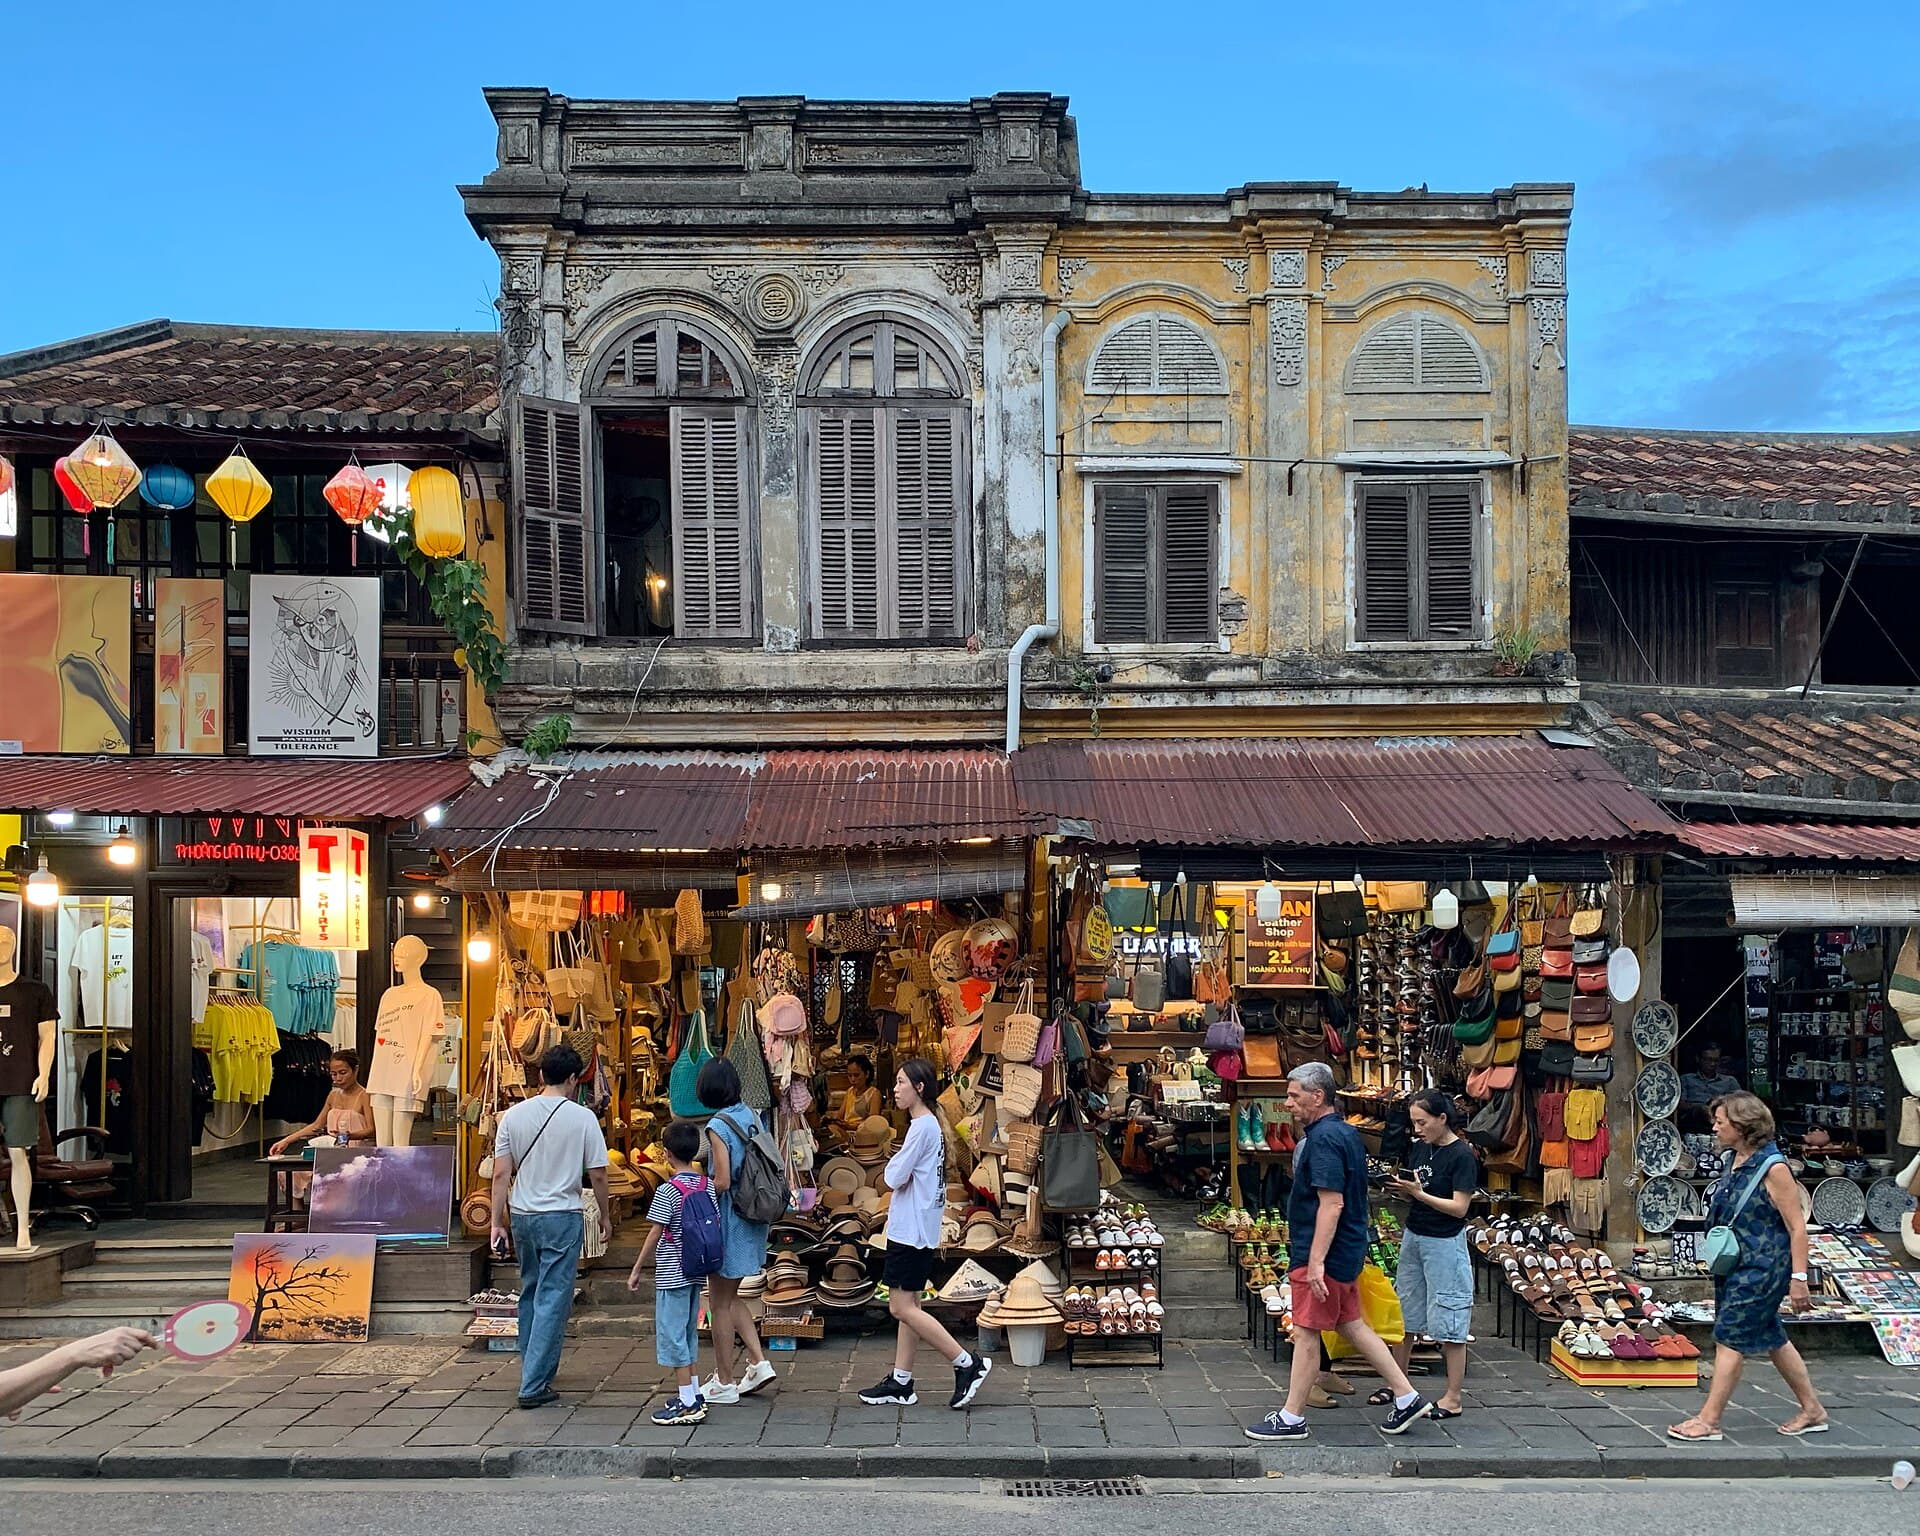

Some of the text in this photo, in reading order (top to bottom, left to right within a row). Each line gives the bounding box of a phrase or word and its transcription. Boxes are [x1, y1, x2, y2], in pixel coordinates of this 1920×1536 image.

[1281, 900, 1311, 917] AN
[1265, 927, 1294, 938] Shop
[1268, 949, 1292, 964] 21
